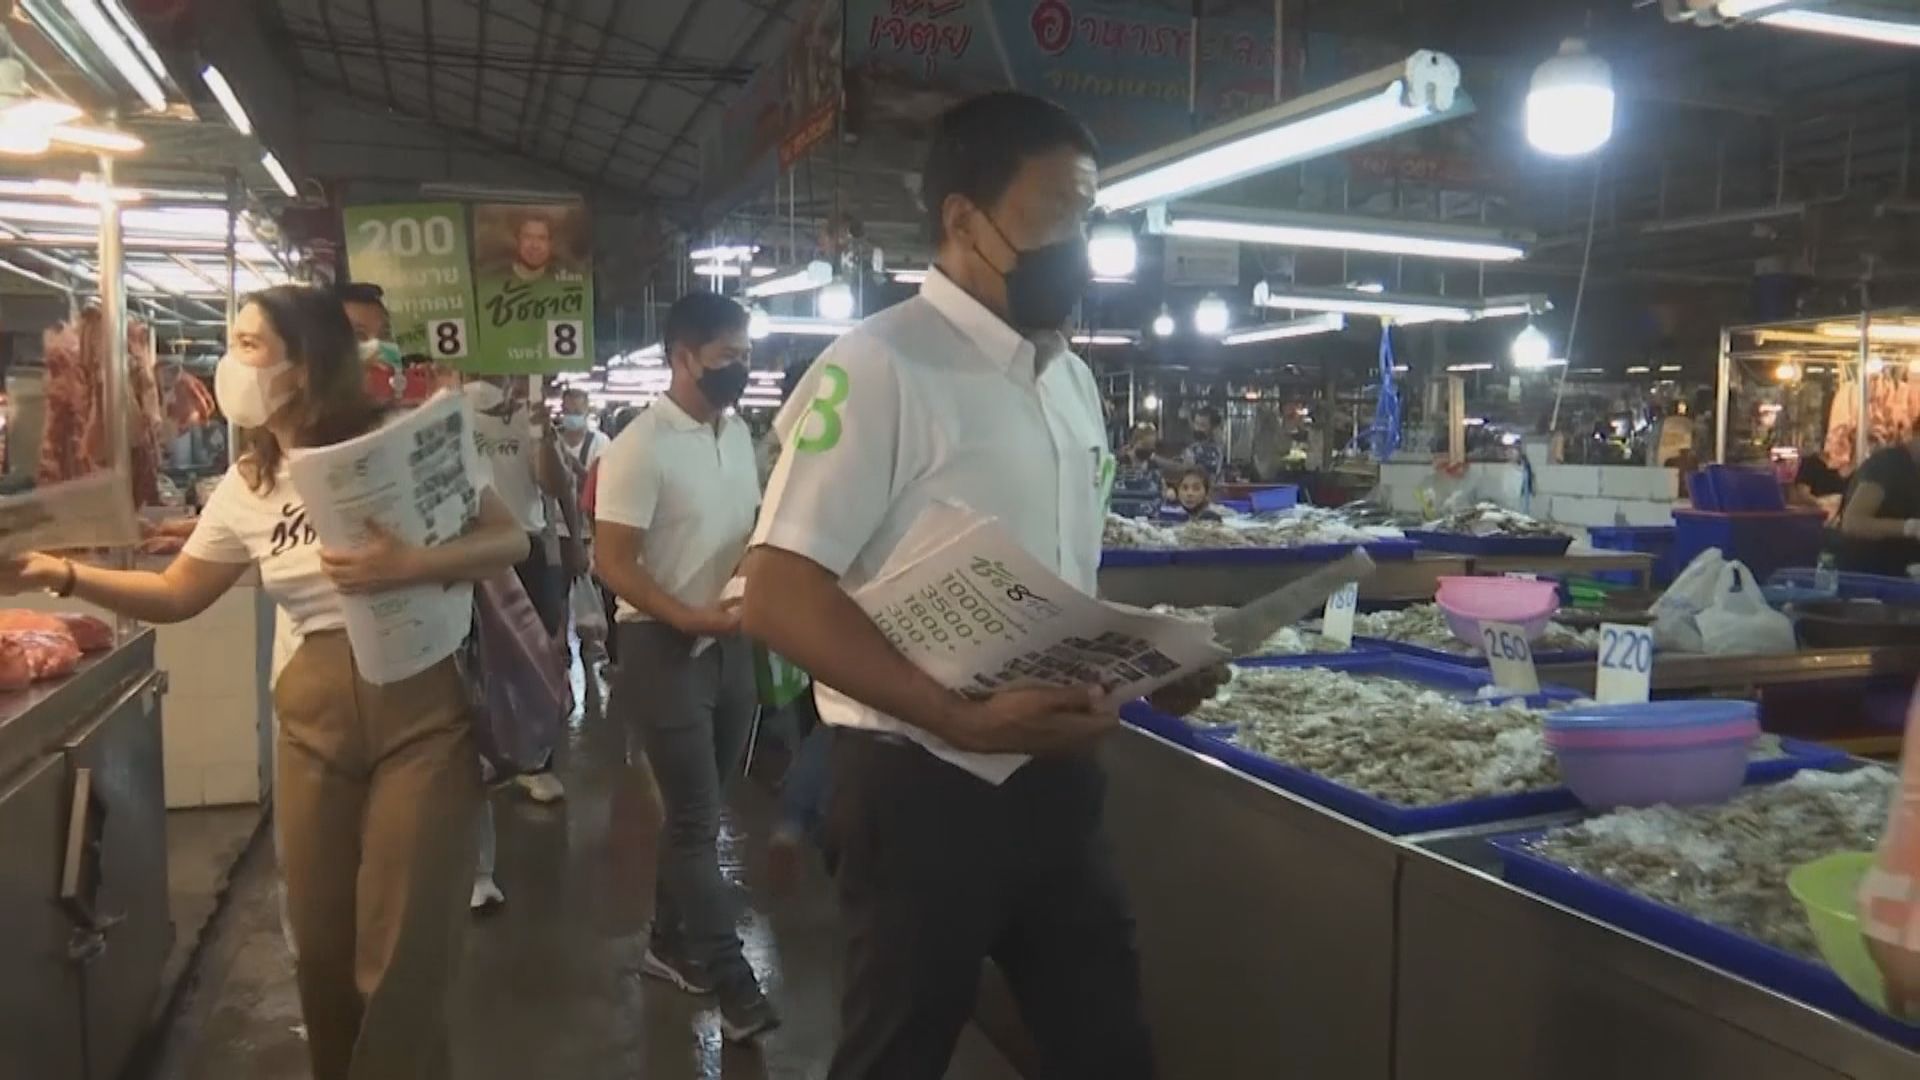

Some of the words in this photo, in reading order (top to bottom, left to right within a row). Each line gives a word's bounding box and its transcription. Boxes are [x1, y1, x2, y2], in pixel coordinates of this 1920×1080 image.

[357, 215, 454, 258] 200
[485, 281, 582, 327] ชัชชาติ
[436, 321, 461, 355] 8
[554, 323, 578, 356] 8
[1483, 627, 1528, 661] 260
[1601, 629, 1651, 673] 220
